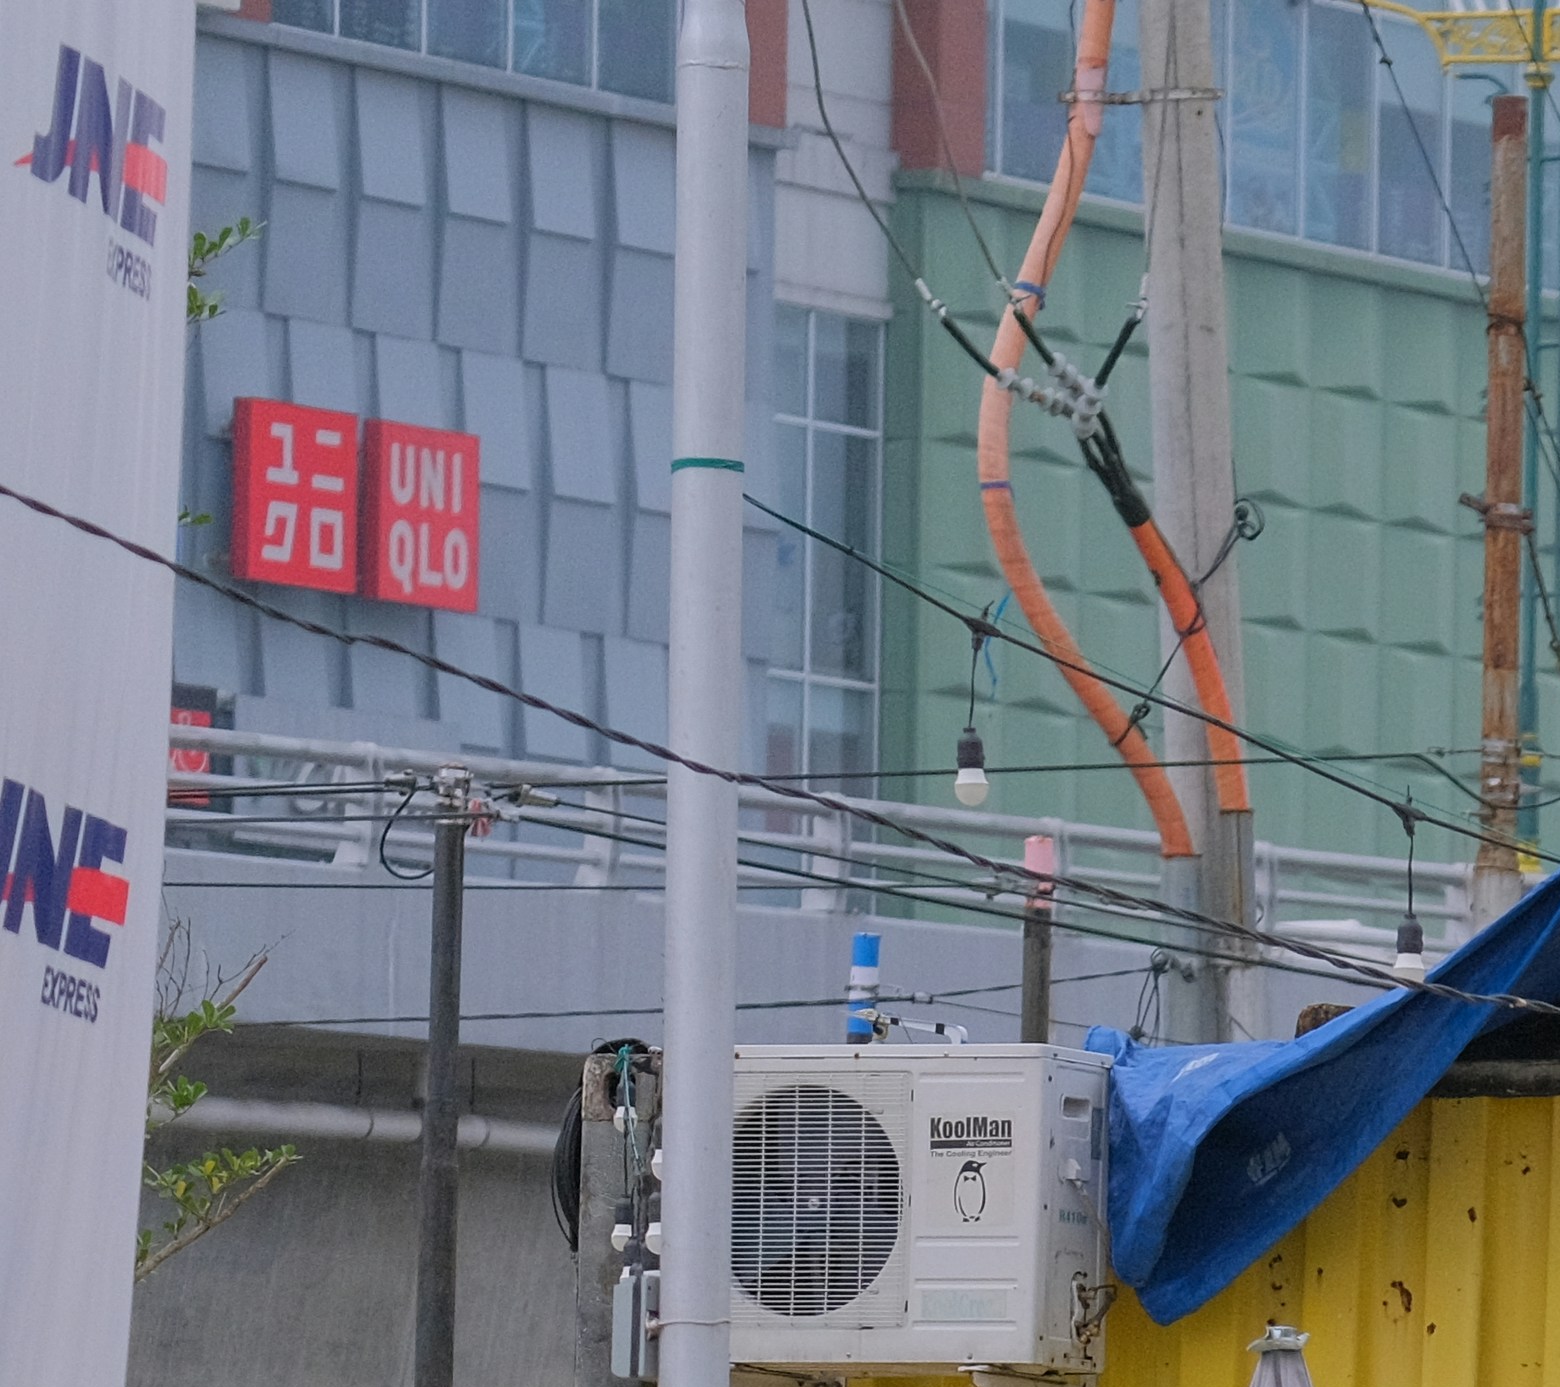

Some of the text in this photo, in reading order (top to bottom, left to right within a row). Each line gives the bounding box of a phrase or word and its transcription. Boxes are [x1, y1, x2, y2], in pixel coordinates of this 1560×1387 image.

[30, 44, 168, 248] JNE
[390, 442, 464, 514] UNI
[389, 519, 470, 594] QLO
[40, 964, 101, 1024] EXPRESS
[930, 1116, 1012, 1139] KoolMan
